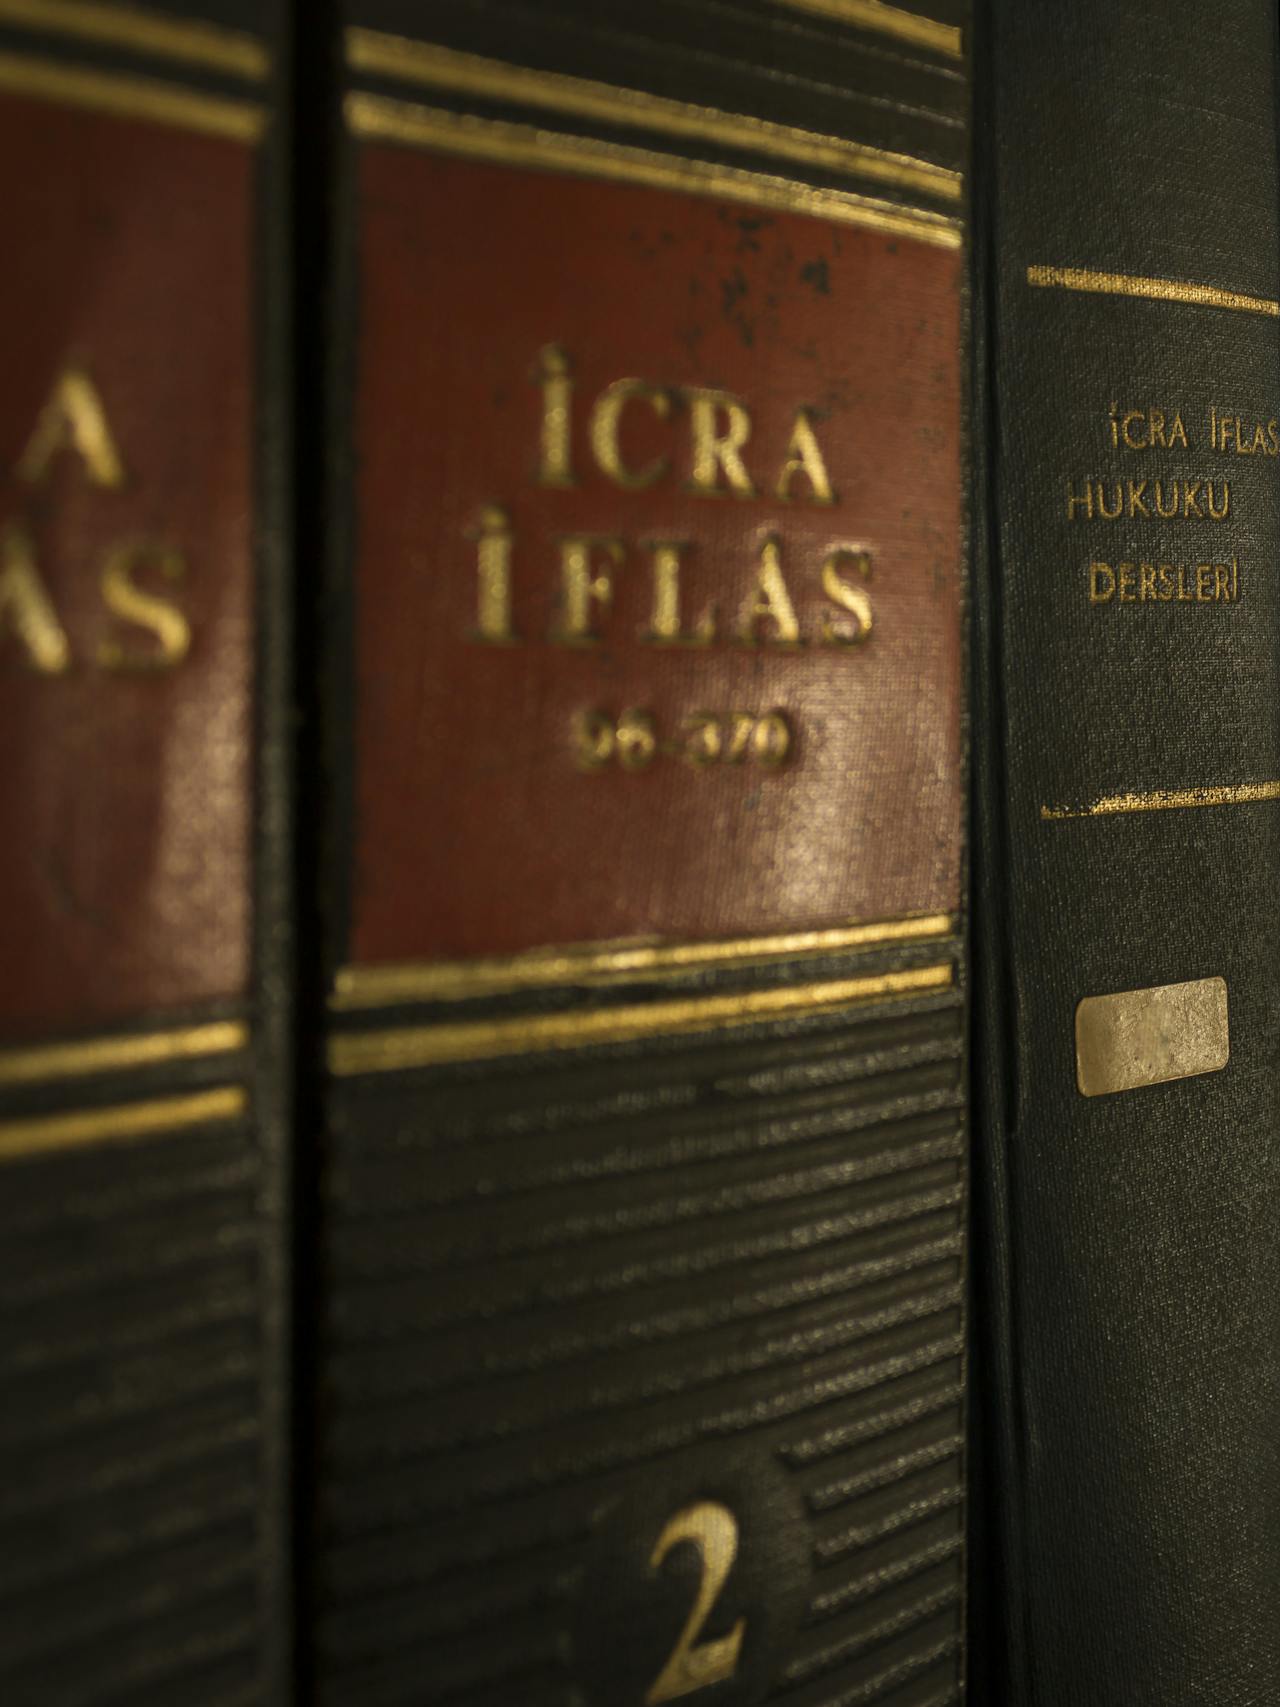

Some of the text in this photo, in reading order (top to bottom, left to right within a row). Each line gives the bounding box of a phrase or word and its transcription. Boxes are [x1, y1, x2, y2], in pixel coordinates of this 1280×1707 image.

[533, 343, 840, 504] İCRA
[1109, 401, 1280, 457] İCRA İFLAS
[1066, 479, 1230, 521] HUKUKU
[1089, 556, 1239, 604] DERSLERİ
[646, 1498, 747, 1705] 2
